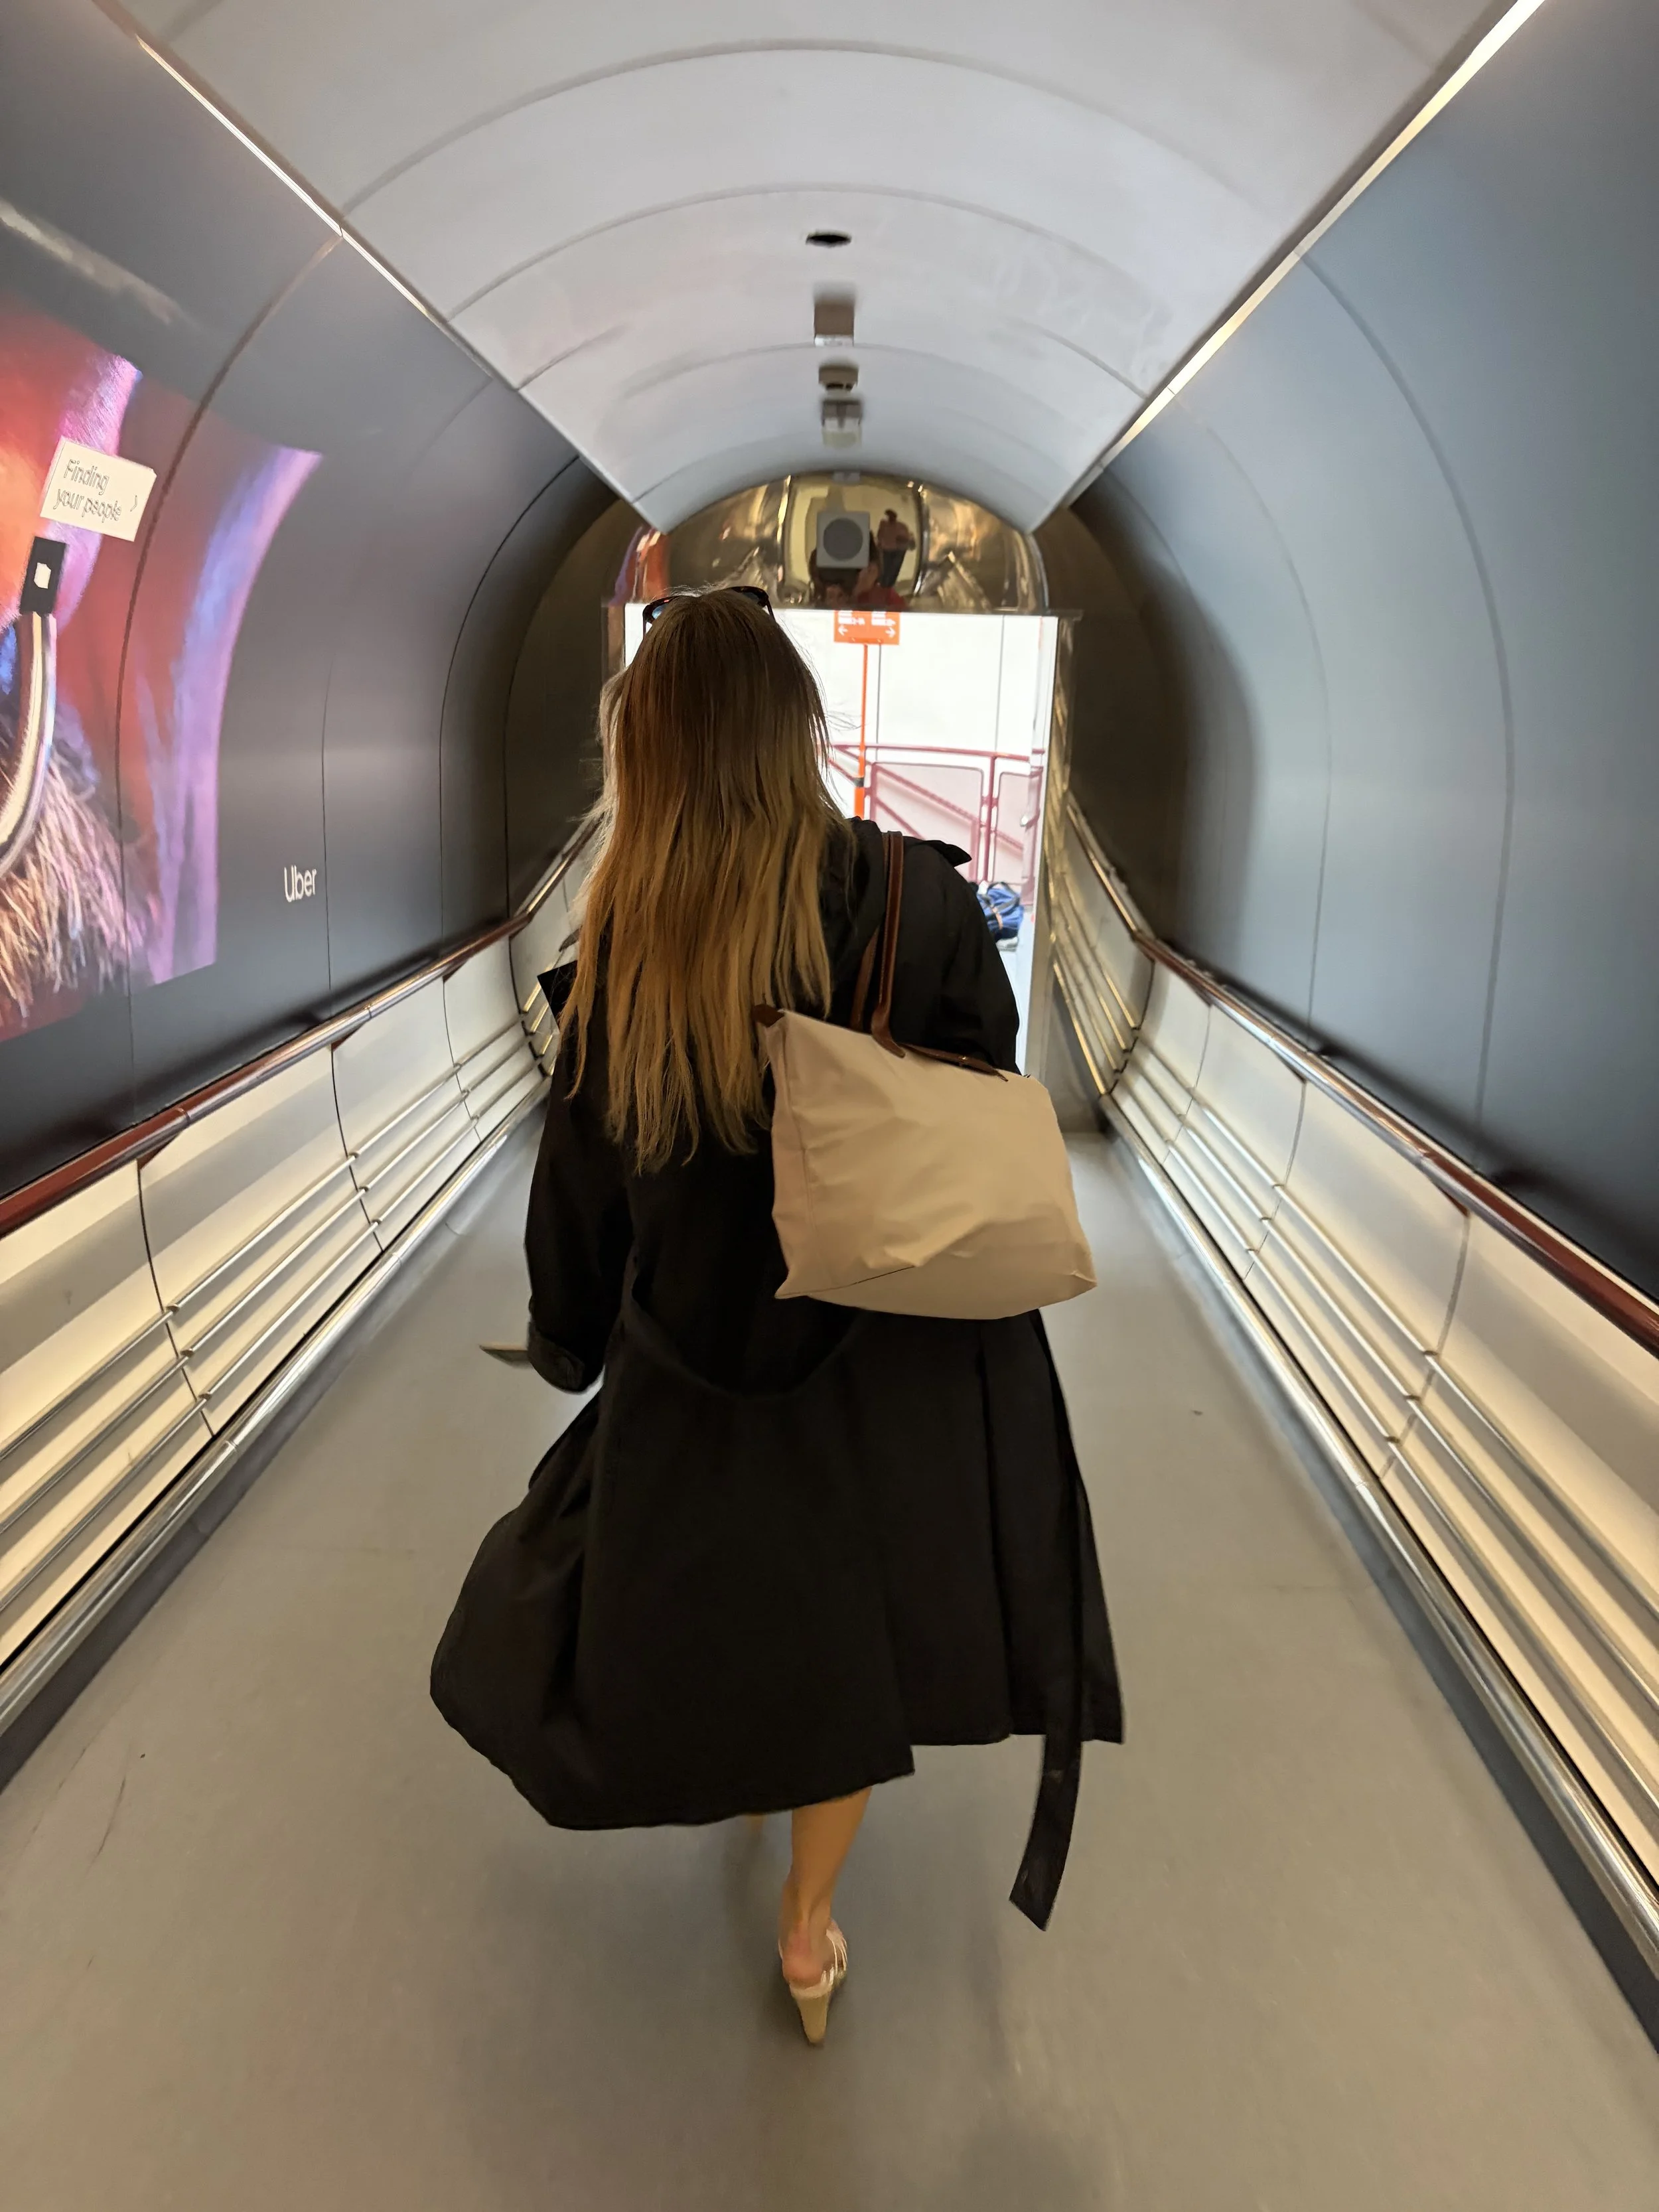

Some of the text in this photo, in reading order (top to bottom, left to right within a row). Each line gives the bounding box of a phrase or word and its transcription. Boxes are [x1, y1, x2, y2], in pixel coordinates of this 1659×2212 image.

[64, 459, 109, 496] Finding
[52, 488, 122, 523] your people
[284, 865, 317, 903] Uber
